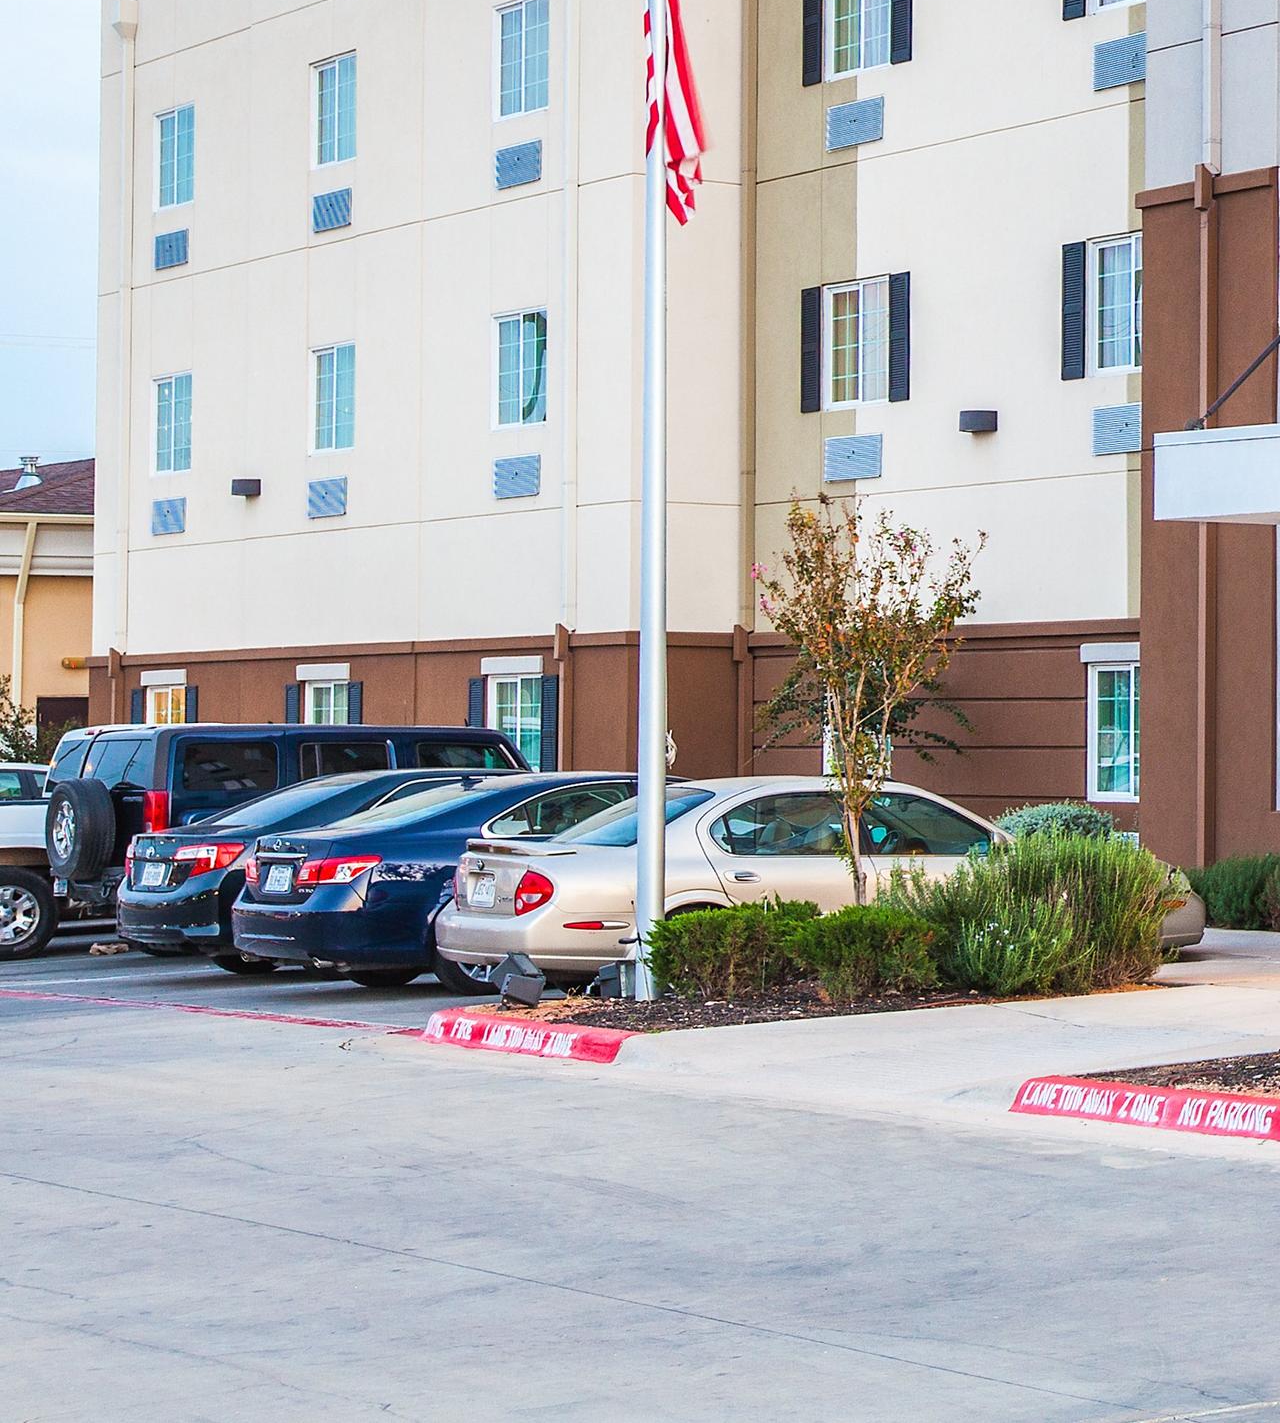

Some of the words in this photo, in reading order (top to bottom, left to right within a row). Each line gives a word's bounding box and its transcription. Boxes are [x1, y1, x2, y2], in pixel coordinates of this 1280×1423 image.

[542, 1031, 578, 1057] ZONE
[1021, 1081, 1059, 1109] LANE
[1117, 1092, 1166, 1123] ZONE
[1177, 1097, 1205, 1127] NO
[1205, 1099, 1277, 1134] PARKING
